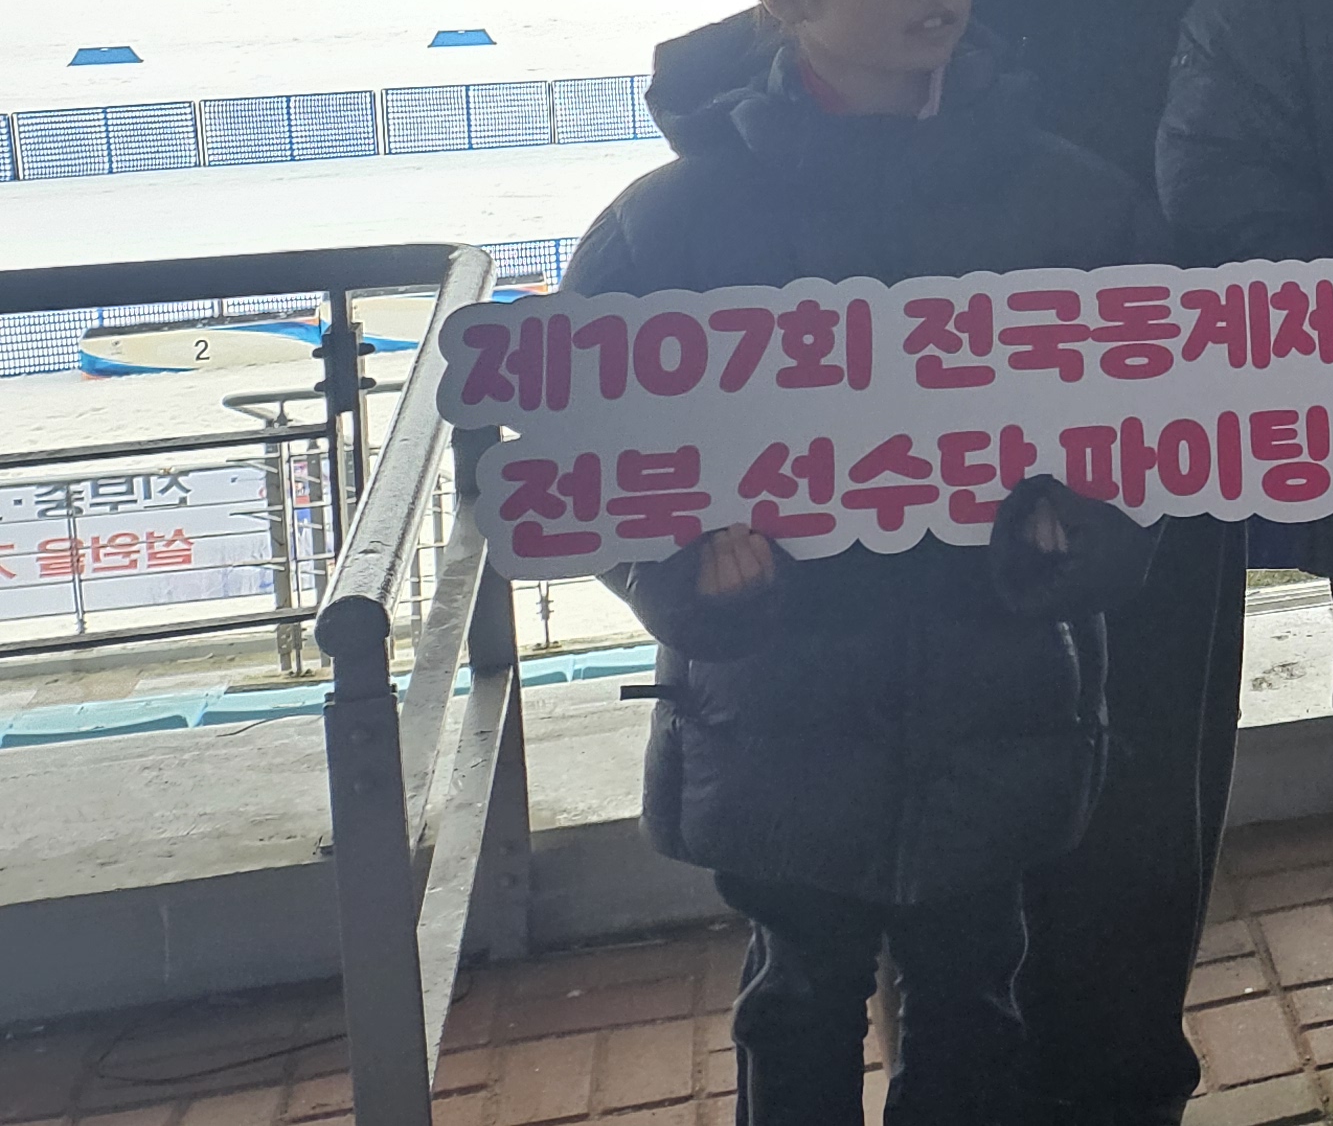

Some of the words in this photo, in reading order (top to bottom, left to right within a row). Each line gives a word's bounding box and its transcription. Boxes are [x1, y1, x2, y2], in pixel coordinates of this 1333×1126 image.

[194, 339, 210, 361] 2
[460, 296, 873, 411] 제107회
[499, 443, 712, 559] 전북
[737, 423, 1038, 539] 선수단
[1059, 404, 1331, 508] 파이팅
